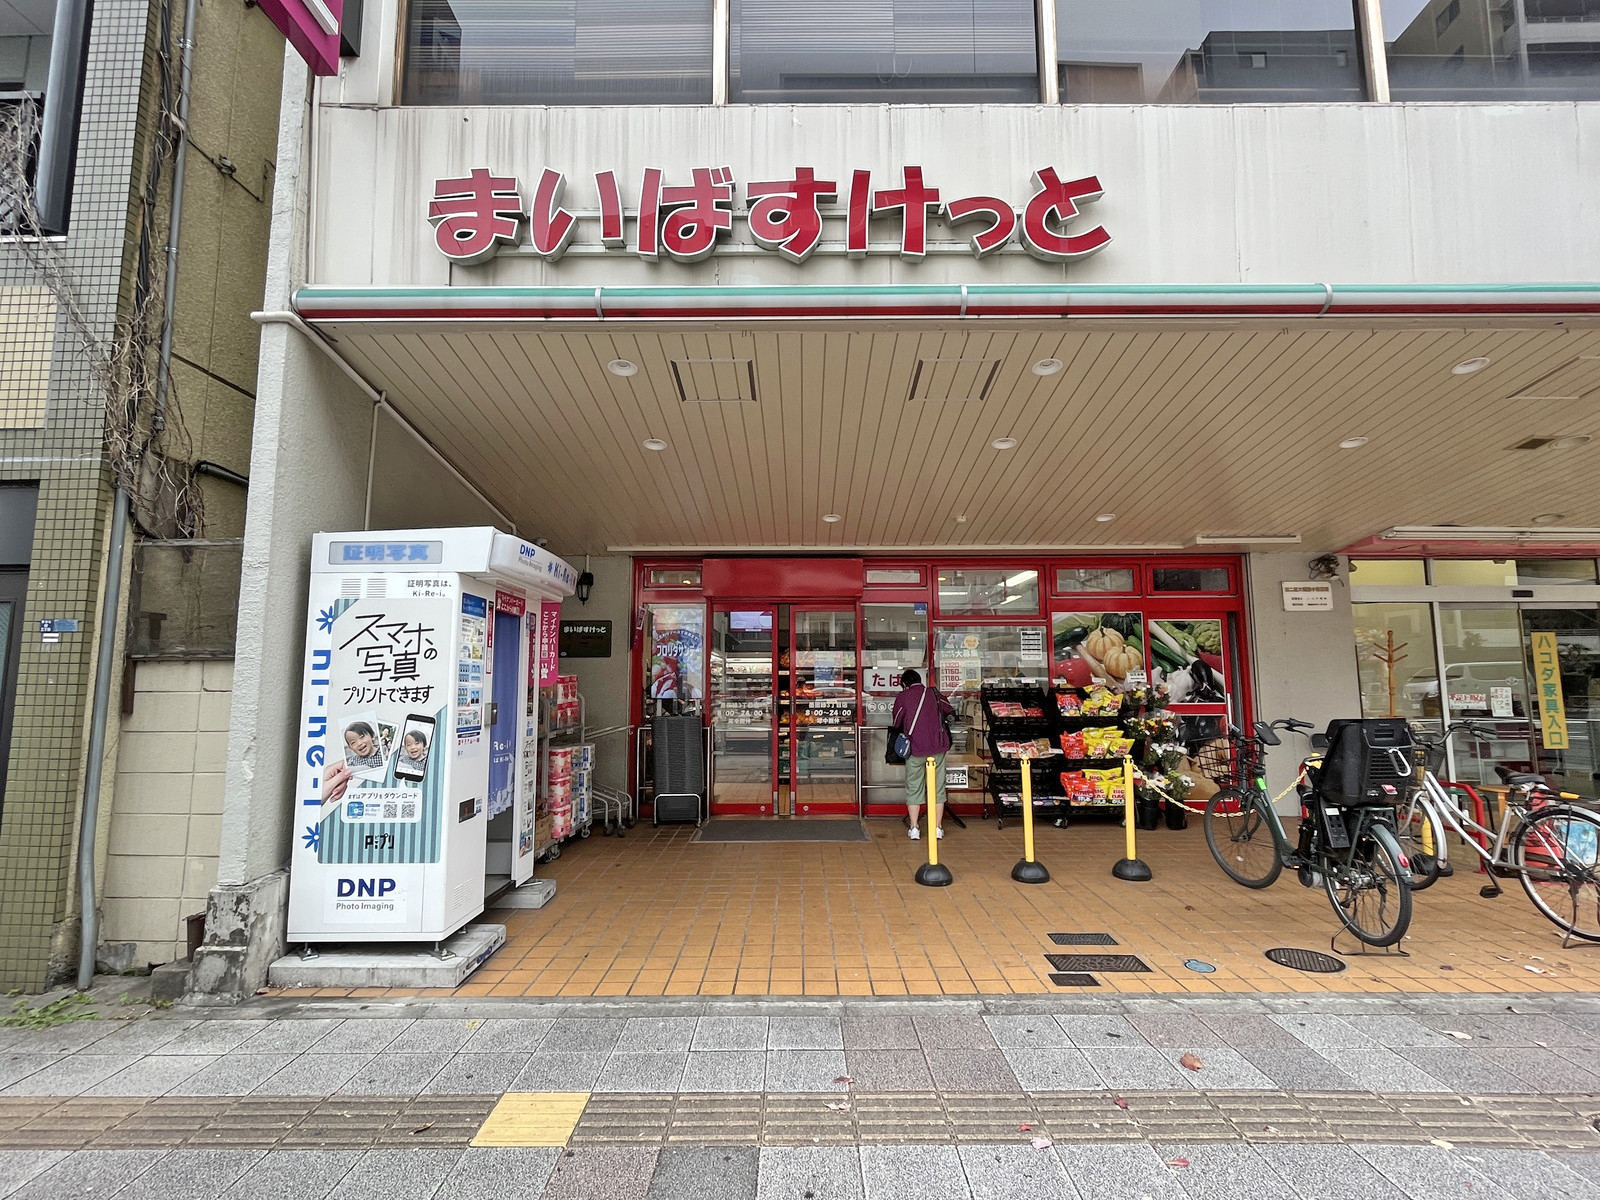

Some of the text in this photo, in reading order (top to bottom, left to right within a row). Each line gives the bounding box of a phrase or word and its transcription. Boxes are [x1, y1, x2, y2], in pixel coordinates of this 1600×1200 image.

[427, 166, 1112, 262] まいばすけっと
[342, 544, 430, 561] 証明写真
[519, 543, 536, 559] DNP
[407, 579, 452, 588] 証明写真は、
[563, 625, 607, 634] まいばすけっと
[549, 611, 558, 671] マイナンバーカード
[356, 645, 421, 682] 写真
[343, 684, 435, 705] プリントできます
[1538, 635, 1563, 746] ハコダ家具入口
[348, 792, 418, 800] まずはアプリをダウンロード
[337, 878, 396, 897] DNP
[336, 902, 394, 911] Photo Imaging
